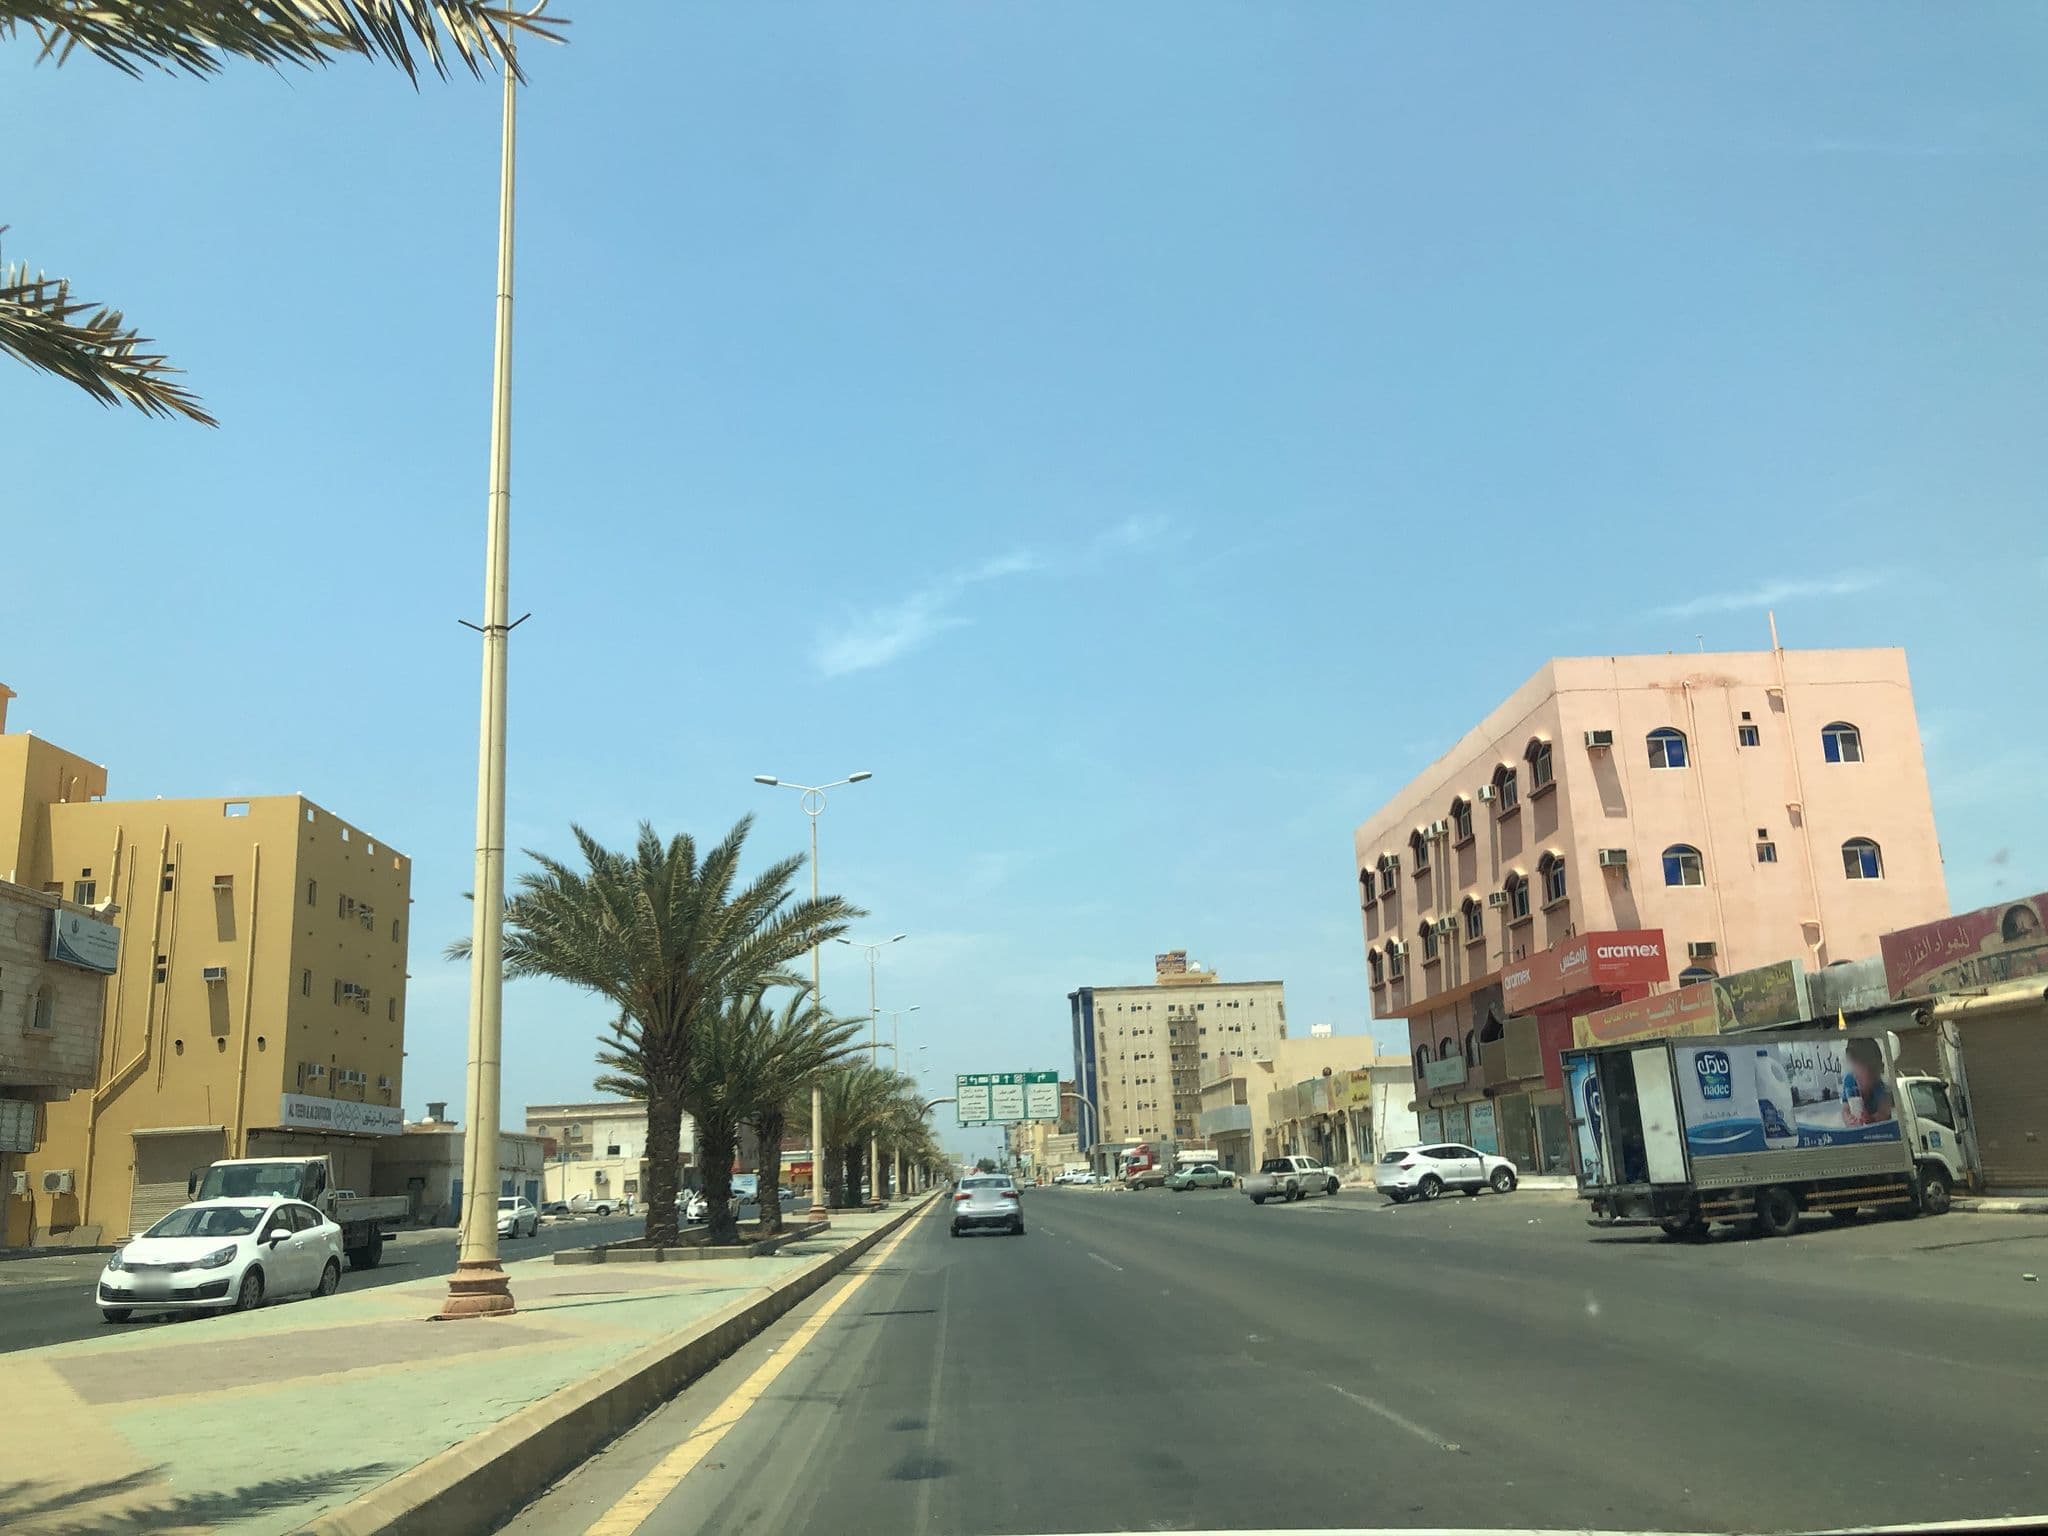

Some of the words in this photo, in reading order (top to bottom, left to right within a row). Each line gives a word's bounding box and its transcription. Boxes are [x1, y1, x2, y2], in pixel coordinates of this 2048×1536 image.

[1596, 944, 1660, 959] aramex
[1504, 967, 1531, 990] aramex
[1789, 1052, 1814, 1070] ماما
[1703, 1084, 1730, 1096] nadec
